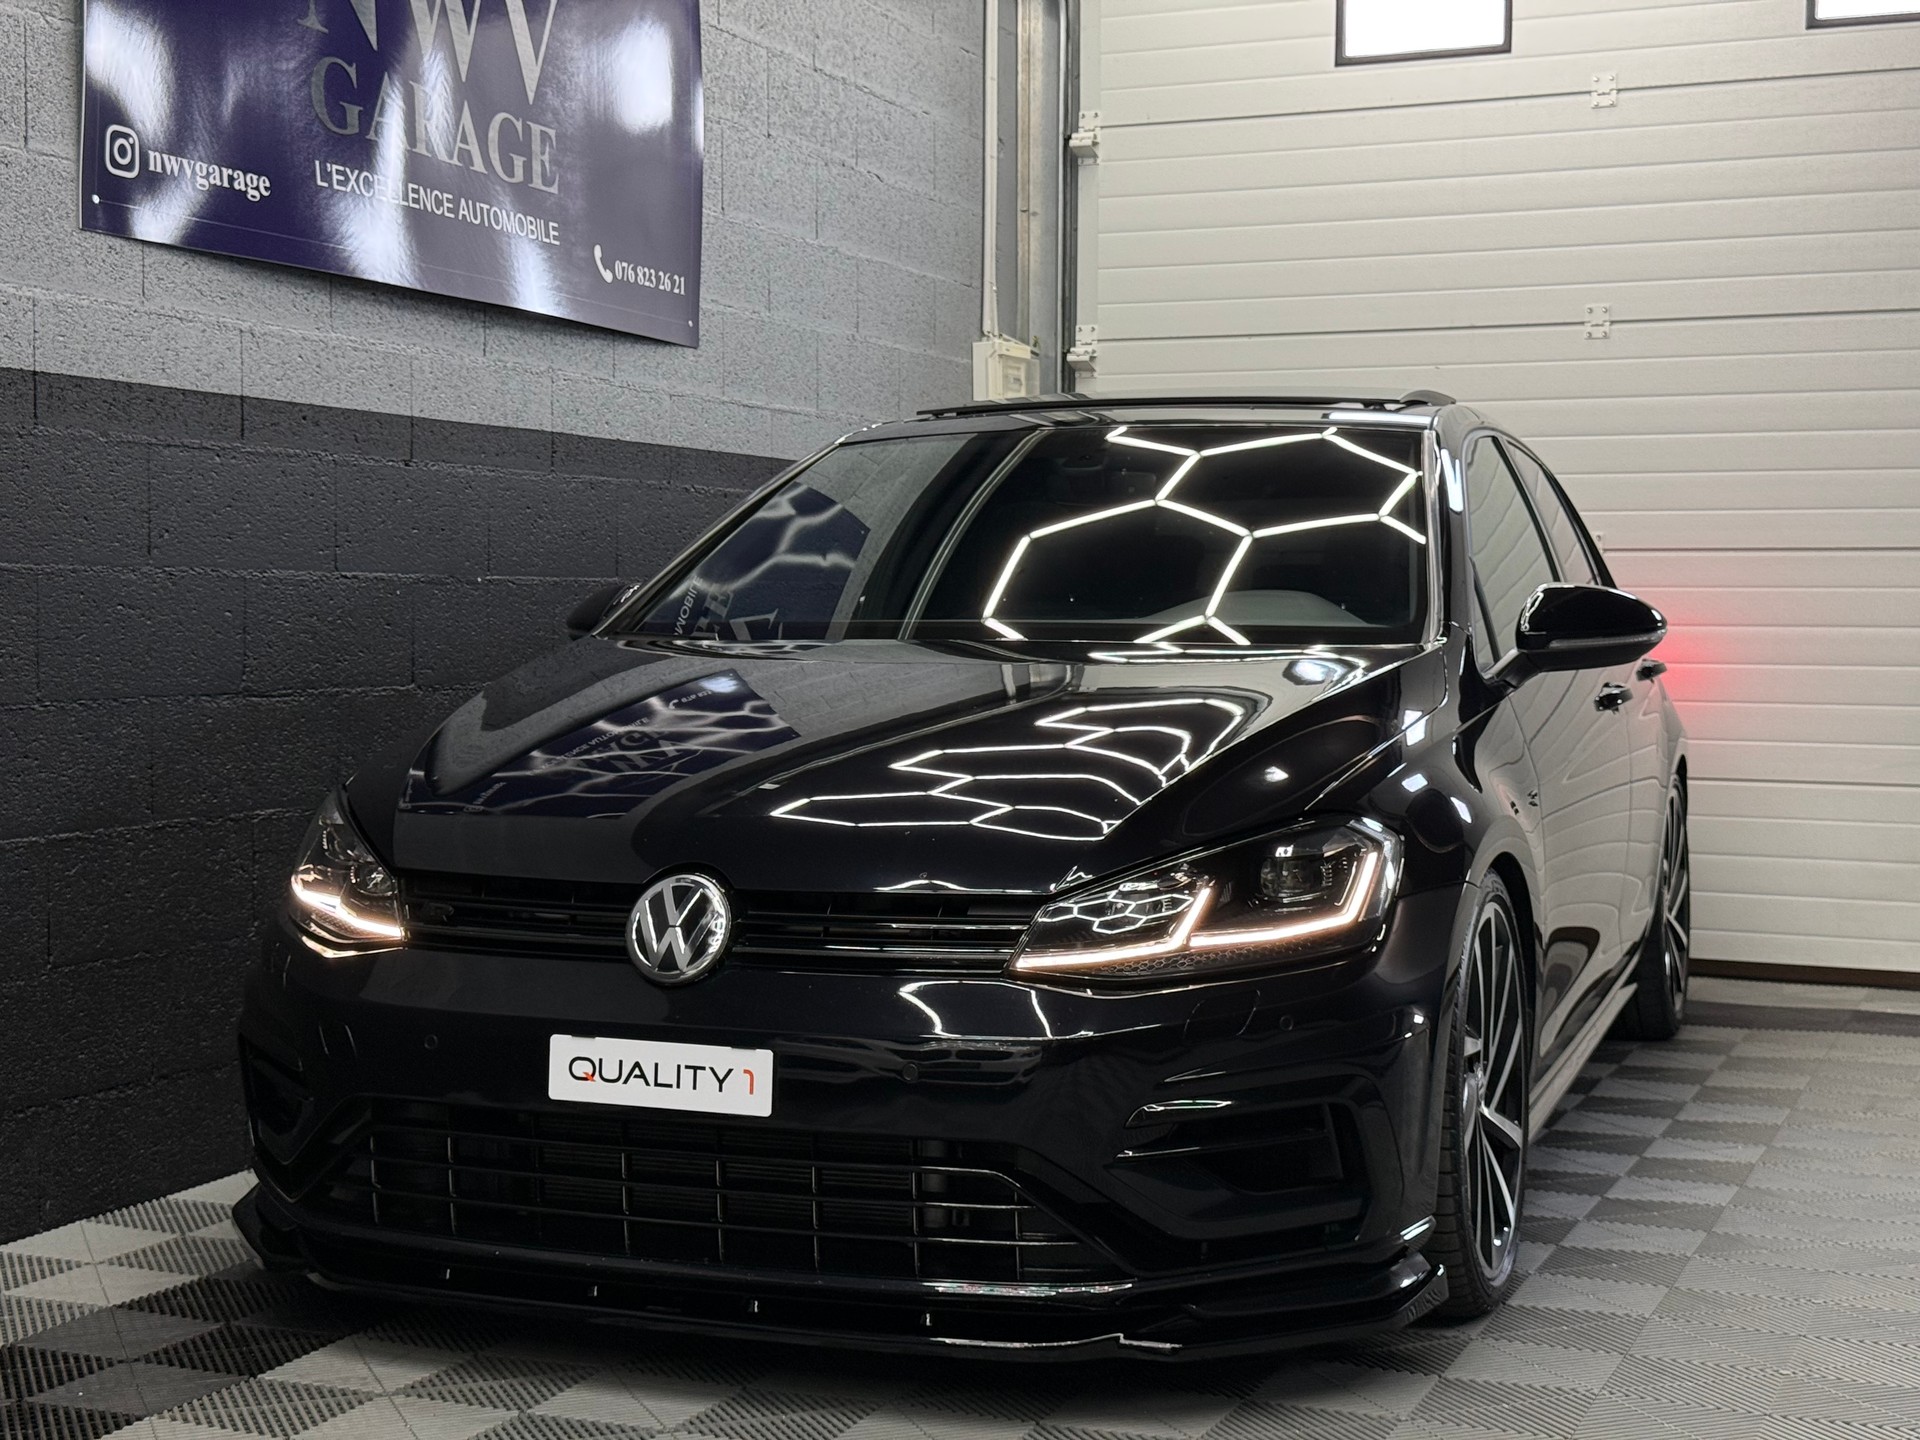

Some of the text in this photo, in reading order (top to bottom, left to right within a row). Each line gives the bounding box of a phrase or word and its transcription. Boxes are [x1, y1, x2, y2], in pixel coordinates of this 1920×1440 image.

[310, 56, 559, 194] GARAGE
[148, 150, 271, 201] nwvgarage
[458, 198, 560, 245] AUTOMOBILE
[615, 260, 685, 295] 076 823 26 21
[568, 1056, 754, 1095] QUALITY 1
